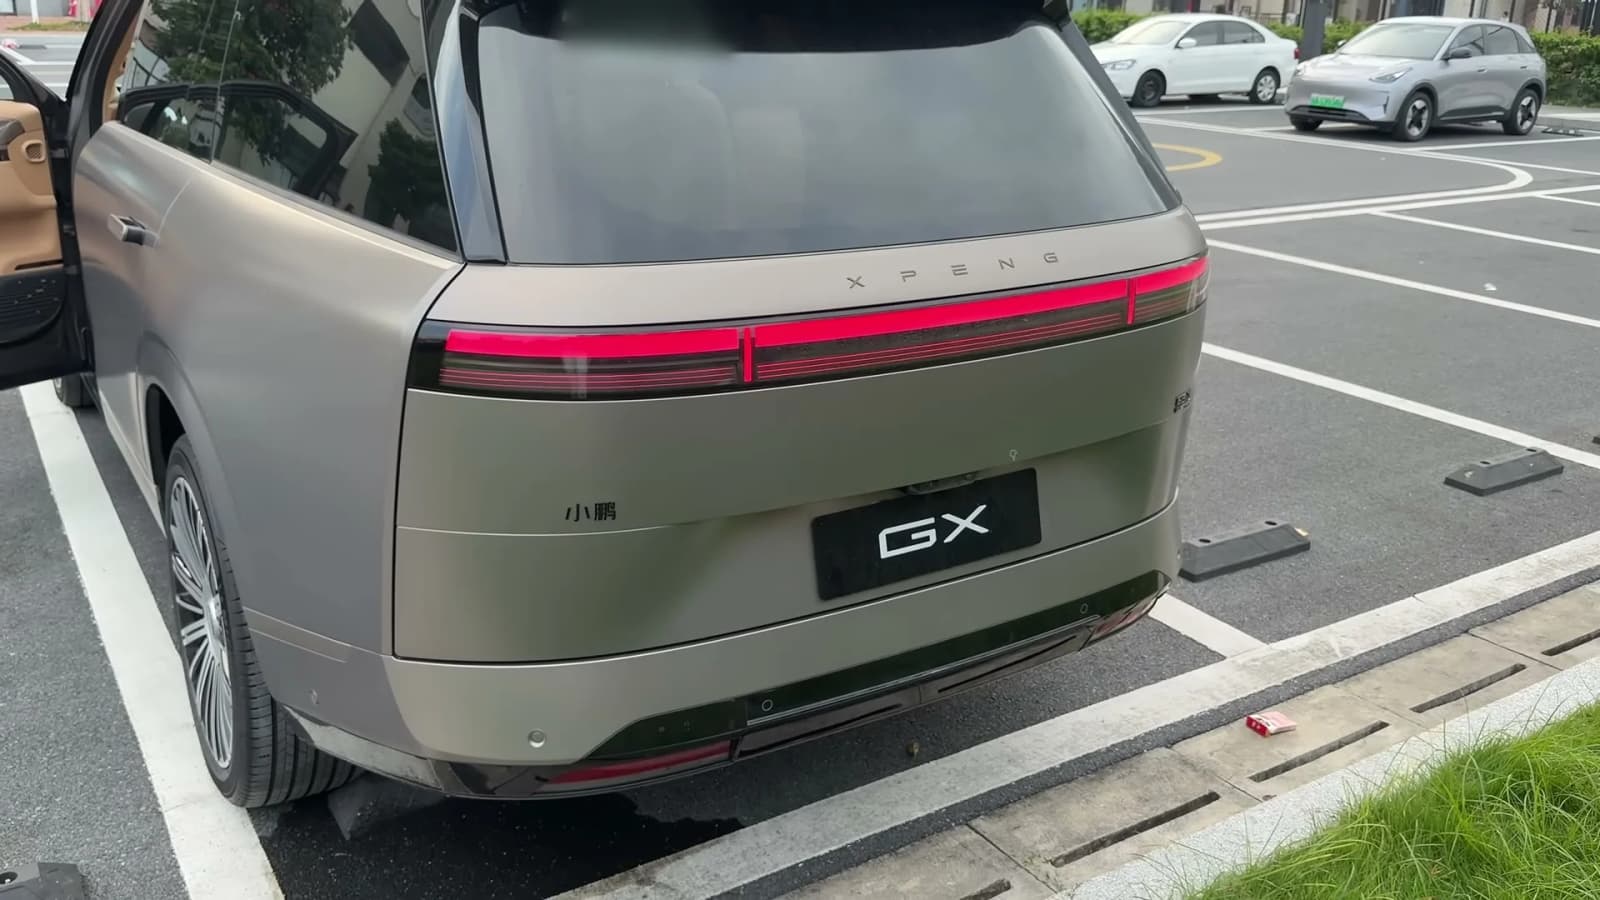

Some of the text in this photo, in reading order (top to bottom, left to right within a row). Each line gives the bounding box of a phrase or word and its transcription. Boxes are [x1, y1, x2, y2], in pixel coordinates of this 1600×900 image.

[846, 252, 1059, 289] XPENG
[565, 501, 617, 522] 小鹏
[878, 504, 990, 559] GX
